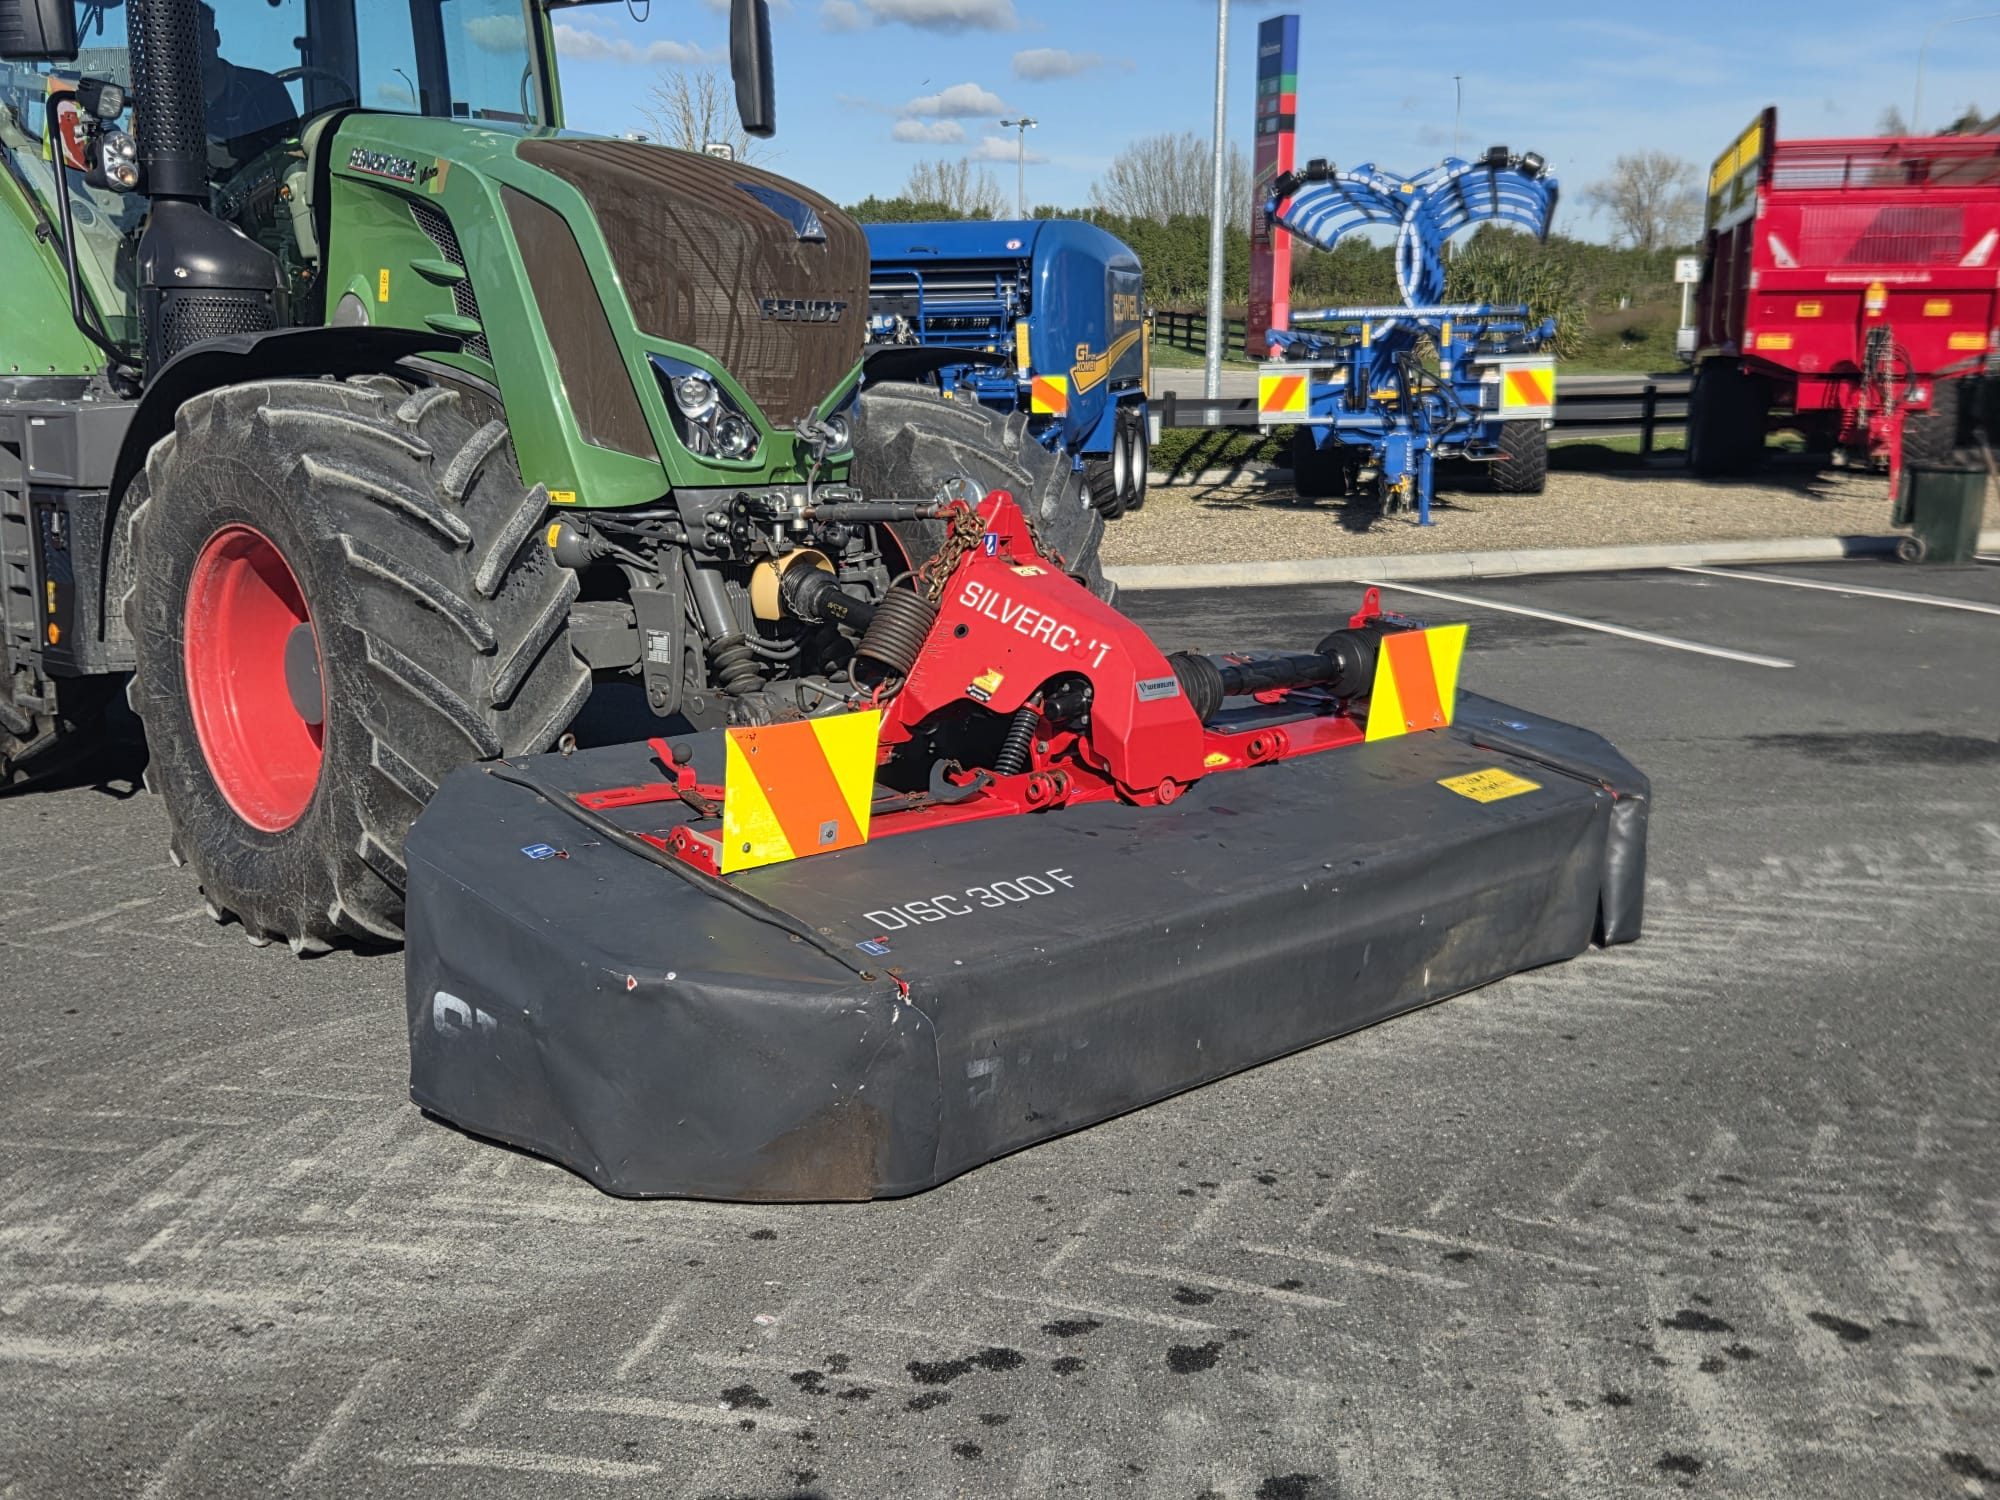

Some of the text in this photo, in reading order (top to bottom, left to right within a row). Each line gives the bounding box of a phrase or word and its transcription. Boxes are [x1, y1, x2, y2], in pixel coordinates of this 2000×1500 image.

[760, 299, 848, 322] FENDT
[959, 581, 1112, 668] SILVERCT
[863, 868, 1075, 930] DISC 300 F
